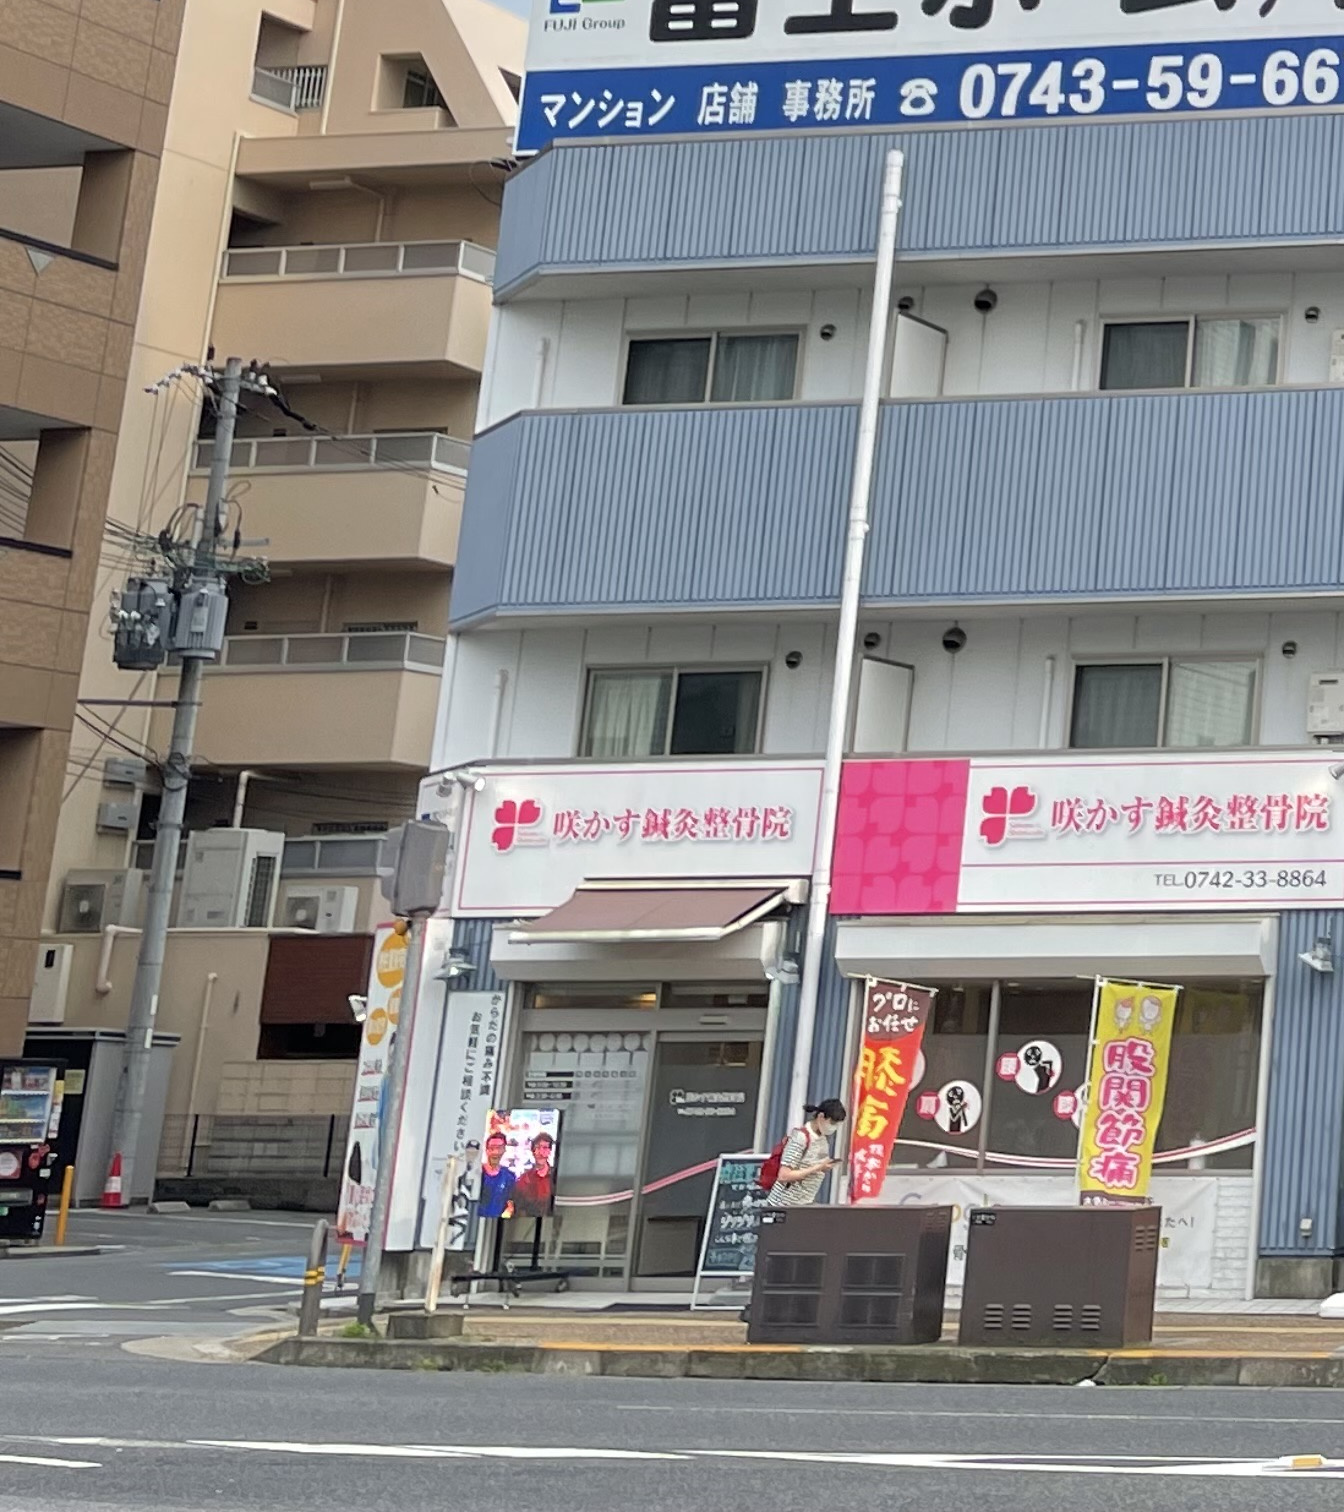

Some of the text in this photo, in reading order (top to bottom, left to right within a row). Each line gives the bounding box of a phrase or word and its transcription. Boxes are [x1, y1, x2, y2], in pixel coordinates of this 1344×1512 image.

[543, 16, 625, 32] FUJI Group
[540, 88, 676, 130] マンション
[697, 80, 758, 126] 店舗
[783, 76, 877, 122] 事務所
[553, 806, 793, 843] 咲かす鍼灸整骨院
[1050, 794, 1330, 835] 咲かす鍼灸整骨院
[872, 991, 921, 1013] プロに
[867, 1014, 919, 1033] お任せ
[1088, 1039, 1156, 1189] 股関節痛
